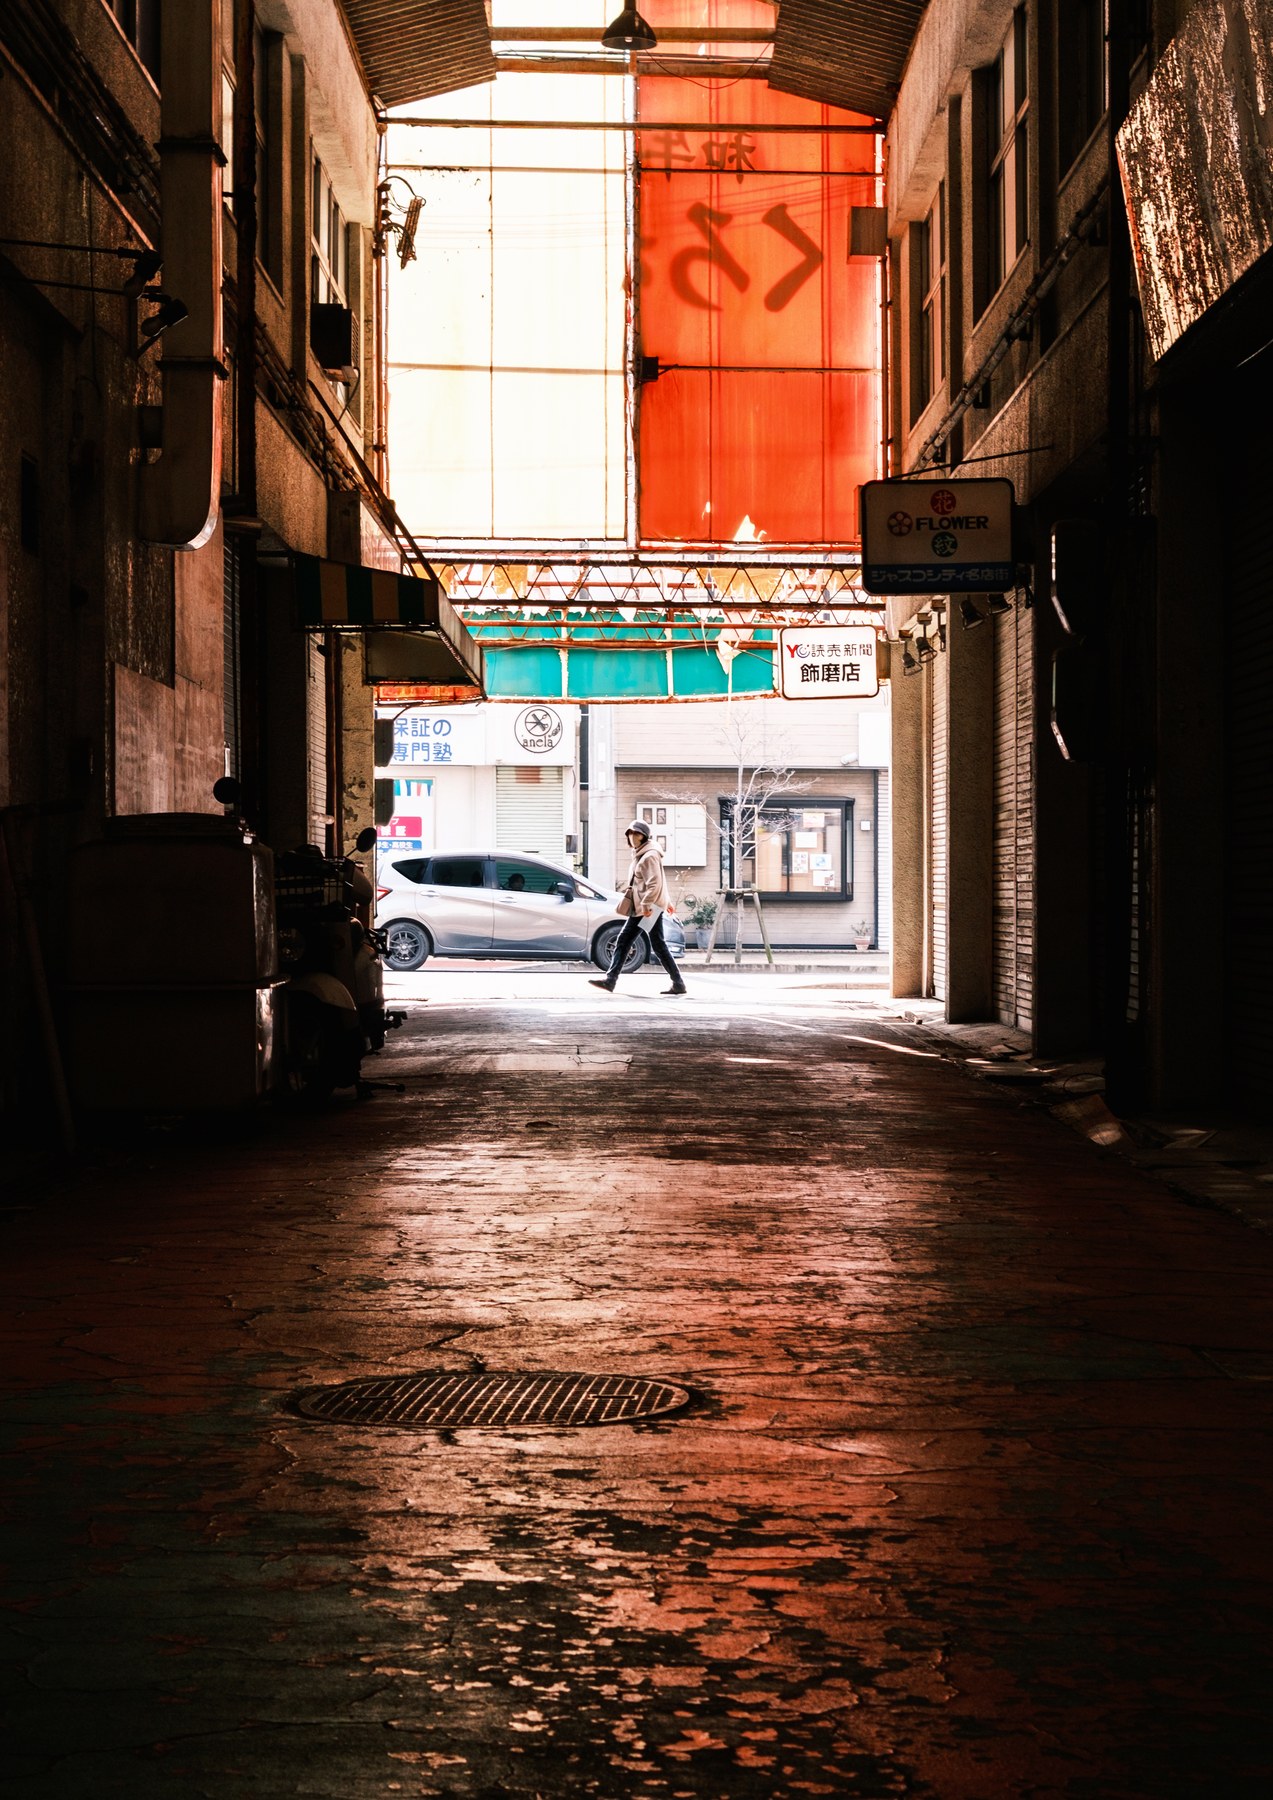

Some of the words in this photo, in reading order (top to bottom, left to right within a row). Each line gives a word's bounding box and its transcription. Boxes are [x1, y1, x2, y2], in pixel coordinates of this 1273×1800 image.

[932, 491, 954, 514] 花
[916, 516, 989, 531] FLOWER
[871, 568, 1009, 583] ジャスコシティ名店街
[811, 643, 873, 657] 読売新聞
[800, 663, 861, 683] 飾磨店
[522, 736, 553, 748] anela
[394, 742, 452, 762] 専門塾
